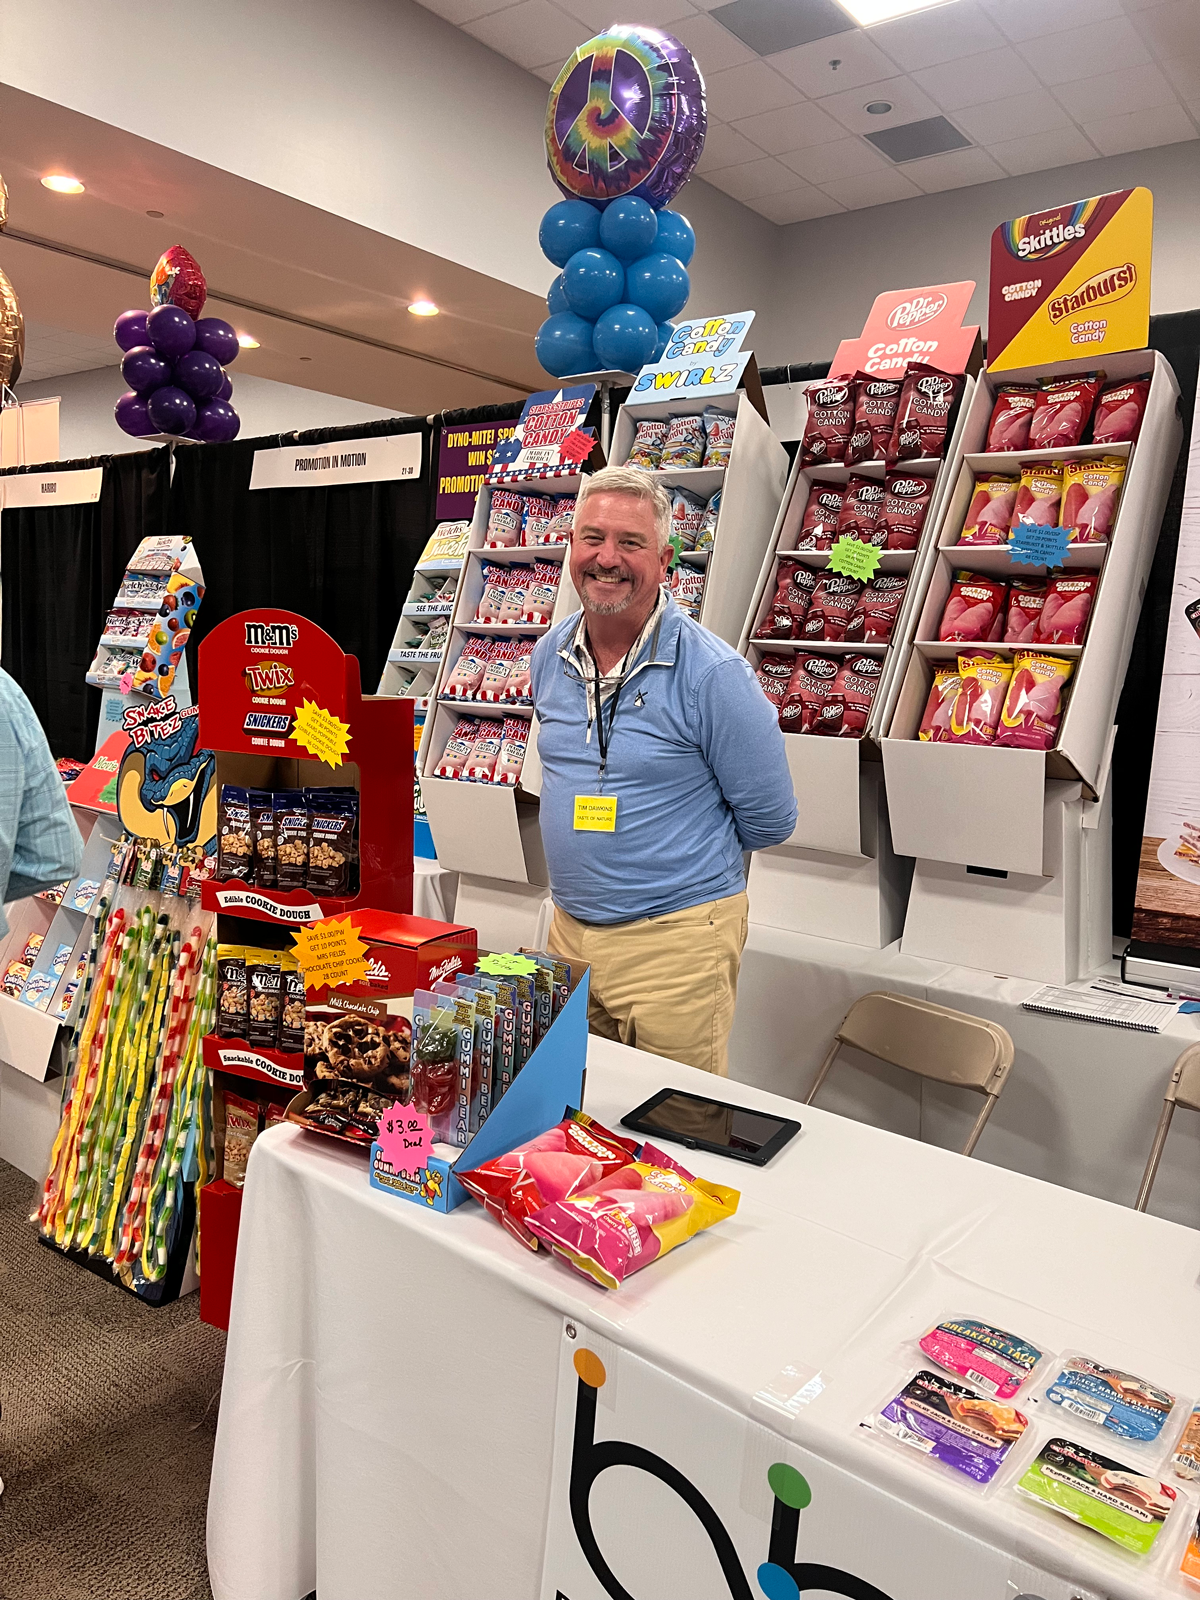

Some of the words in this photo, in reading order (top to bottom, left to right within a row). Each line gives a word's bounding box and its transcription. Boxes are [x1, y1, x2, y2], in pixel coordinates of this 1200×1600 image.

[1017, 223, 1085, 257] Skittles
[1001, 279, 1042, 295] COTTON
[1004, 288, 1038, 302] CANDY
[1050, 263, 1136, 320] Starburst
[909, 297, 932, 312] Dr
[891, 300, 943, 328] Pepper
[671, 318, 746, 343] Cotton
[1070, 319, 1107, 333] Cotton
[1070, 330, 1105, 345] Candy
[666, 335, 736, 359] Candy
[867, 337, 939, 358] Cotton
[634, 363, 738, 391] SWIRLZ
[1047, 390, 1081, 401] COTTON
[523, 409, 580, 432] COTTON
[671, 418, 697, 432] Cotton
[448, 429, 494, 448] DYNO-MITE!
[521, 427, 568, 448] CANDY
[295, 456, 330, 471] PROMOTION
[332, 455, 338, 468] IN
[340, 453, 367, 468] MOTION
[468, 451, 486, 466] WIN
[905, 480, 918, 489] Dr
[1082, 472, 1109, 481] Cotton
[1082, 479, 1107, 488] Candy
[41, 483, 57, 493] HARIBO
[894, 481, 925, 494] Pepper
[887, 499, 923, 510] COTTON
[887, 506, 917, 517] CANDY
[269, 698, 286, 706] DOUGH
[124, 697, 174, 728] SNAKE
[312, 709, 322, 718] SAVE
[245, 713, 289, 730] SNICKERS
[324, 725, 338, 738] POINTS
[252, 737, 268, 746] COOKIE
[269, 738, 285, 747] DOUGH
[311, 734, 325, 746] COOKIE
[325, 744, 340, 757] DOUGH
[312, 743, 326, 755] COUNT
[312, 819, 345, 831] SNICKERS
[224, 896, 243, 904] Edible
[245, 895, 277, 915] COOKIE
[279, 908, 311, 920] DOUGH
[306, 934, 319, 942] SAVE
[310, 944, 319, 952] GET
[328, 939, 347, 947] POINTS
[329, 950, 346, 958] FIELDS
[302, 962, 332, 973] CHOCOLATE
[345, 956, 366, 966] COOKIE
[330, 970, 348, 978] COUNT
[329, 997, 342, 1007] Milk
[343, 1000, 367, 1012] Chocolate
[520, 1001, 532, 1059] GUMMI
[502, 1009, 514, 1068] GUMMI
[479, 1017, 493, 1079] GUMMI
[223, 1055, 254, 1064] Snackable
[255, 1058, 288, 1080] COOKIE
[456, 1094, 468, 1145] BEAR
[403, 1137, 423, 1149] Deal
[567, 1128, 608, 1158] CANDY
[569, 1124, 617, 1160] COTTON
[603, 1215, 618, 1228] cherry
[943, 1322, 1006, 1350] BREAKFAST
[1007, 1347, 1036, 1364] TACO
[1092, 1387, 1130, 1409] Provolone
[1132, 1405, 1159, 1420] Cheese
[1098, 1383, 1123, 1399] HARD
[1126, 1397, 1162, 1415] SALAMI
[910, 1400, 930, 1413] COLBY
[930, 1410, 946, 1421] JACK
[952, 1421, 971, 1433] HARD
[972, 1430, 997, 1444] SALAMI
[1045, 1466, 1071, 1483] PEPPER
[1071, 1479, 1091, 1493] JACK
[1097, 1491, 1118, 1504] HARD
[1119, 1502, 1149, 1519] SALAMI
